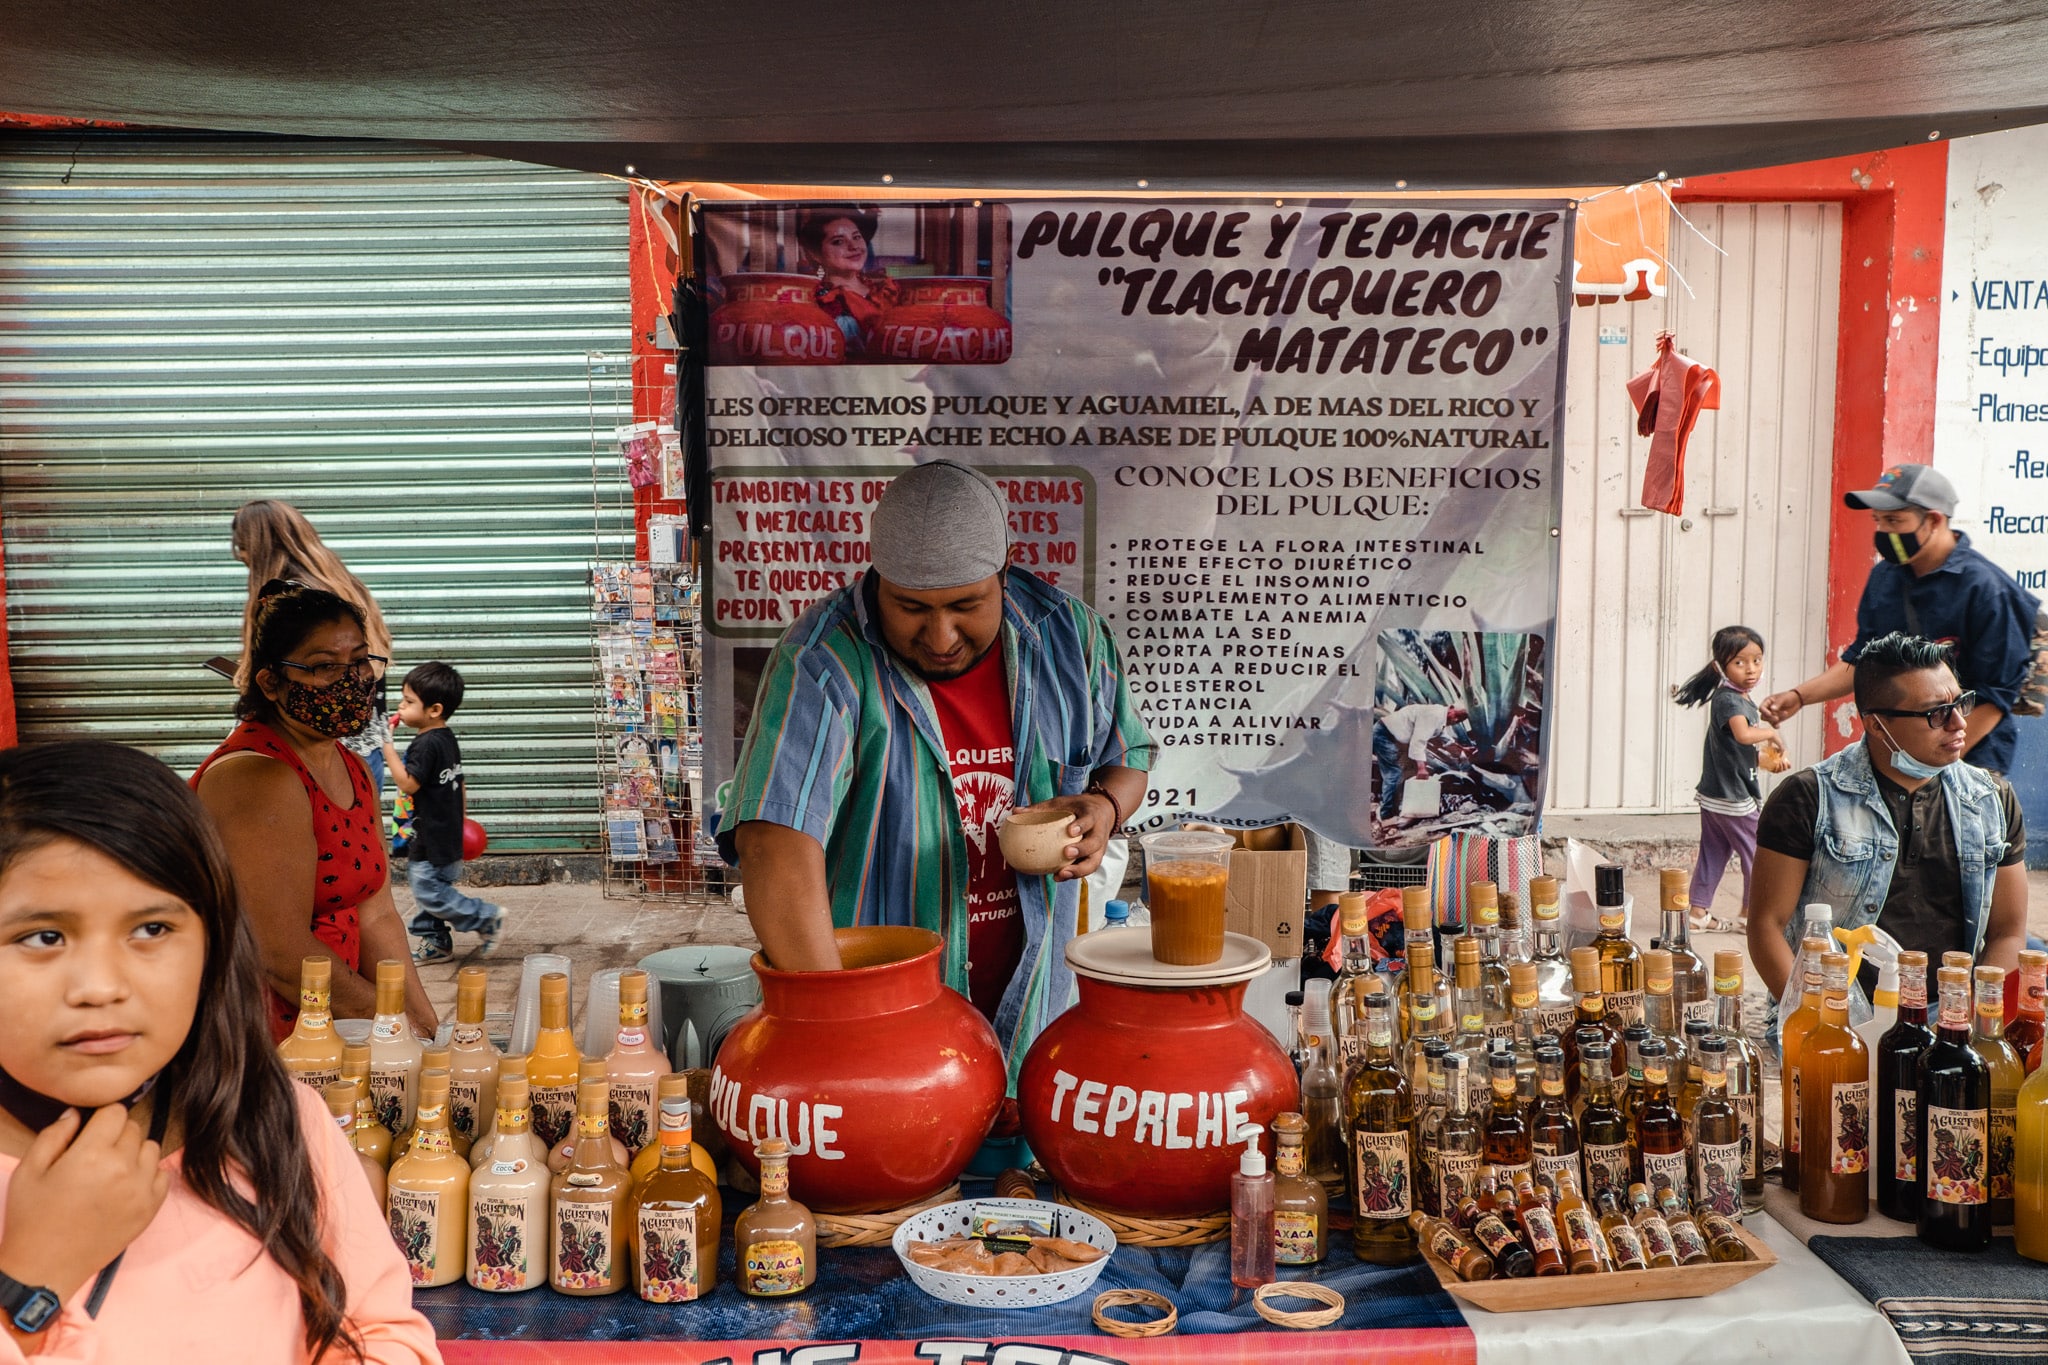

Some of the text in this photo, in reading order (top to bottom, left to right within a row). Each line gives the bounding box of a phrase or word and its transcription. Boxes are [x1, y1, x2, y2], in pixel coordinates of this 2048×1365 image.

[1016, 208, 1561, 263] PULQUE Y TEPACHE
[1097, 266, 1502, 320] "TLACHIQUERO
[716, 322, 838, 360] PULQUE
[883, 322, 1012, 362] TEPACHE
[1232, 326, 1549, 376] MATATECO"
[708, 395, 1540, 420] LES OFRECEMOS PULQUE Y AGUAMIEL, A DE MAS DEL RICO Y
[707, 427, 848, 448] DELICIOSO
[852, 426, 983, 447] TEPACHE
[988, 427, 1066, 447] ECHO
[1071, 427, 1095, 446] A
[1098, 427, 1172, 448] BASE
[1179, 428, 1217, 448] DE
[1223, 428, 1338, 452] PULQUE
[2009, 450, 2048, 479] -Re
[1114, 465, 1542, 490] CONOCE LOS BENEFICIOS
[818, 480, 855, 504] LES
[1216, 494, 1431, 522] DEL PULQUE:
[736, 511, 749, 532] Y
[756, 510, 864, 534] MEZCALES
[1010, 541, 1077, 566] ES NO
[1127, 538, 1486, 555] PROTEGE LA FLORA INTESTINAL
[1127, 553, 1413, 572] TIENE EFECTO DIURÉTICO
[735, 570, 761, 592] TE
[1127, 573, 1371, 589] REDUCE EL INSOMNIO
[717, 598, 783, 622] PEDIR
[1126, 591, 1467, 608] ES SUPLEMENTO ALIMENTICIO
[1126, 608, 1367, 624] COMBATE LA ANEMIA
[1127, 626, 1292, 640] CALMA LA SED
[1127, 640, 1346, 659] APORTA PROTEÍNAS
[1127, 662, 1361, 677] AYUDA A REDUCIR EL
[1129, 679, 1266, 694] COLESTEROL
[1140, 697, 1252, 711] ACTANCIA
[1144, 715, 1322, 731] YUDA A ALIVIAR
[1163, 732, 1285, 747] GASTRITIS.
[946, 746, 1015, 767] LQUER
[1147, 787, 1197, 808] 921
[609, 1088, 651, 1105] GUSTON
[709, 1064, 846, 1160] PULQUE
[1050, 1069, 1250, 1150] TEPACHE
[1275, 1228, 1314, 1239] AXACA
[747, 1256, 803, 1271] OAXACA
